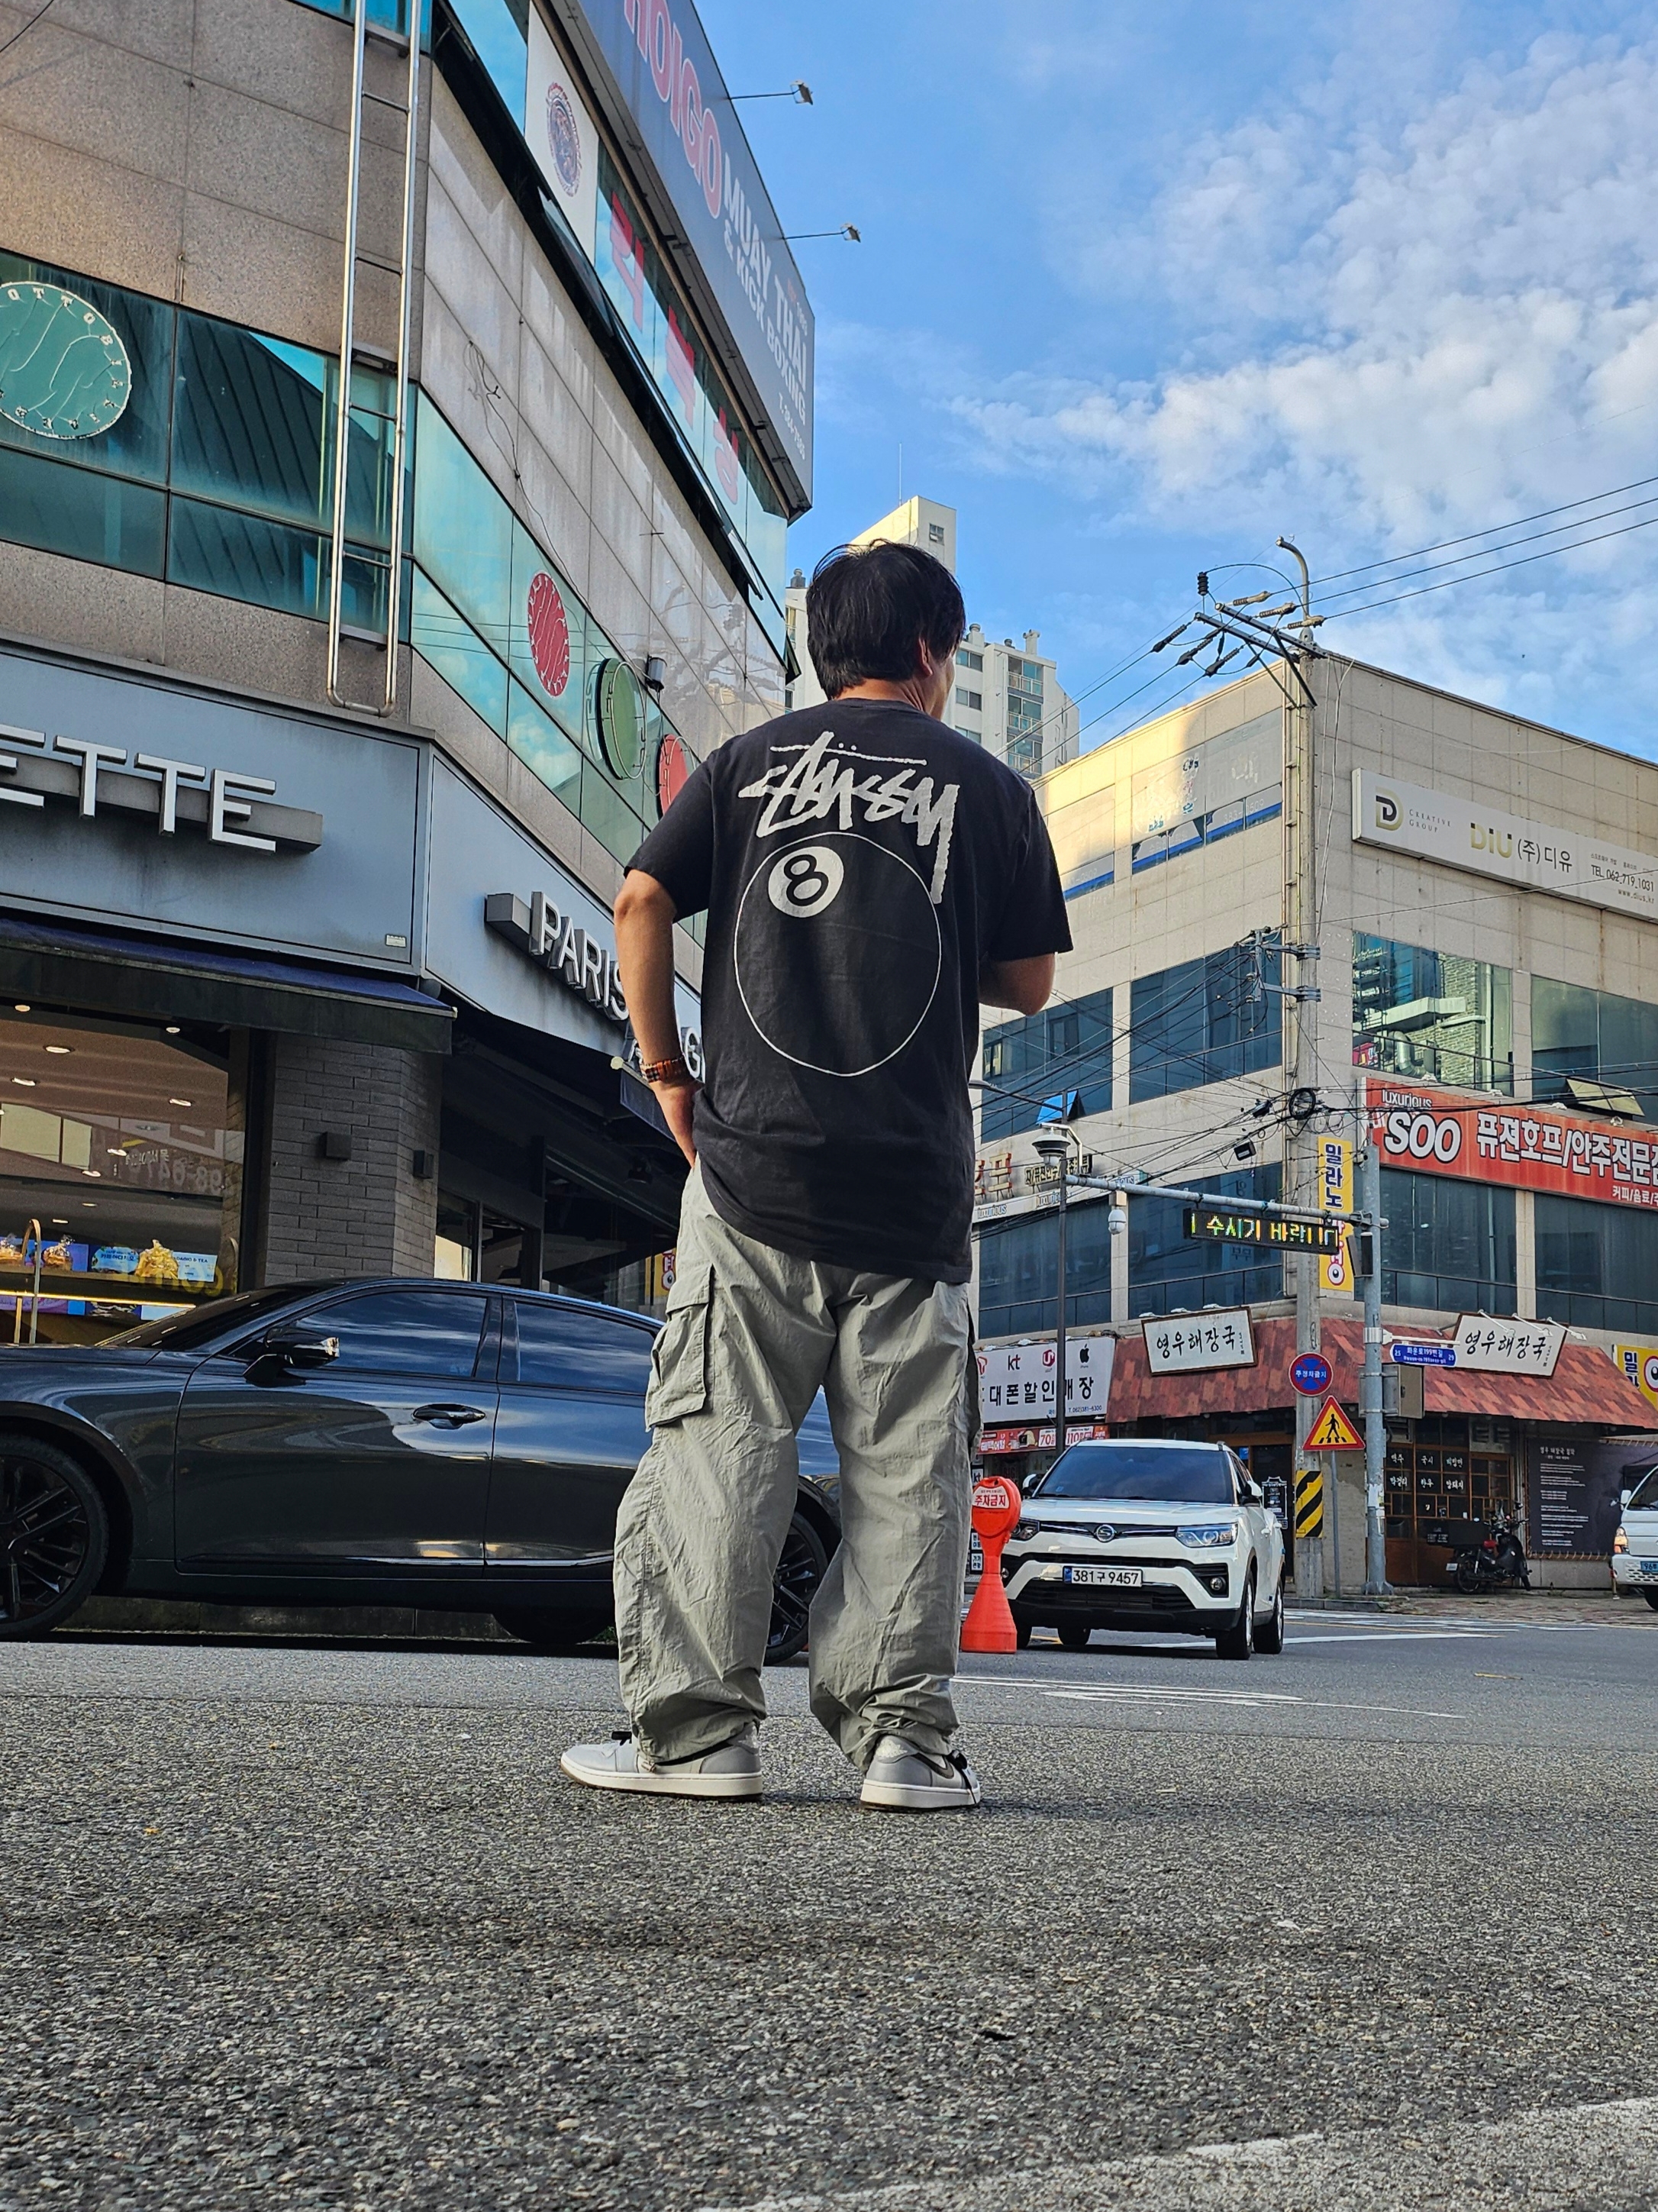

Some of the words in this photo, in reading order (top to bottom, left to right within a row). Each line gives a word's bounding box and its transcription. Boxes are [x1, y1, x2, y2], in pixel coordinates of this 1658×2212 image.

[724, 152, 772, 302] MUAY
[774, 273, 808, 394] THAI
[737, 244, 766, 334] KICK
[766, 315, 806, 428] BOXING
[1408, 809, 1451, 827] CREATIVE
[1408, 819, 1438, 833] GROUP
[1382, 1088, 1433, 1109] luxurious
[1383, 1111, 1462, 1164] SOO
[1156, 1325, 1236, 1359] 영우해장국
[1465, 1329, 1547, 1362] 영우해장국
[1008, 1354, 1021, 1371] kt
[974, 1494, 1006, 1507] 주차금지
[1108, 1571, 1139, 1585] 9457
